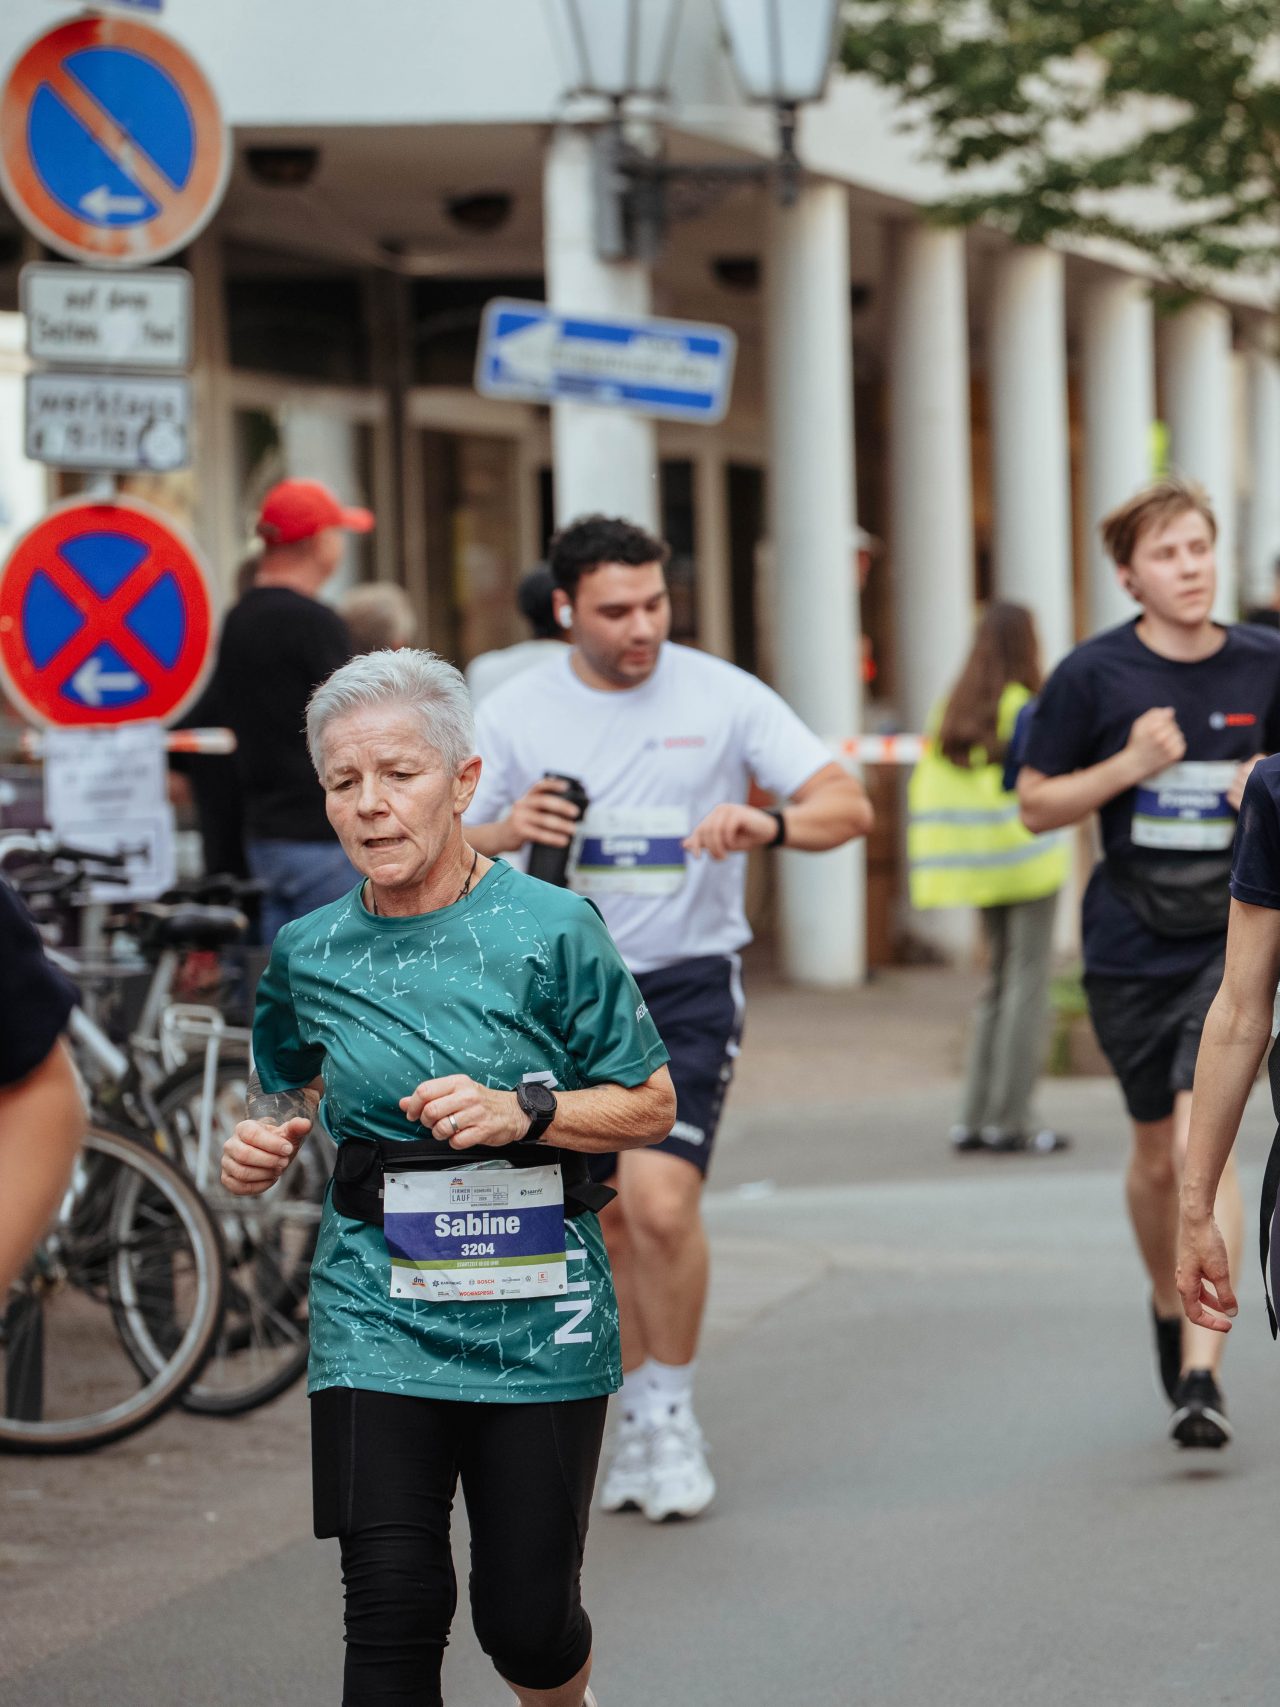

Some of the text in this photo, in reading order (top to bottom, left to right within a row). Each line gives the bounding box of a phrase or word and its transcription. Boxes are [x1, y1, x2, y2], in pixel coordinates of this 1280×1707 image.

[451, 1194, 470, 1202] LAUF
[434, 1212, 521, 1238] Sabine
[460, 1242, 495, 1256] 3204
